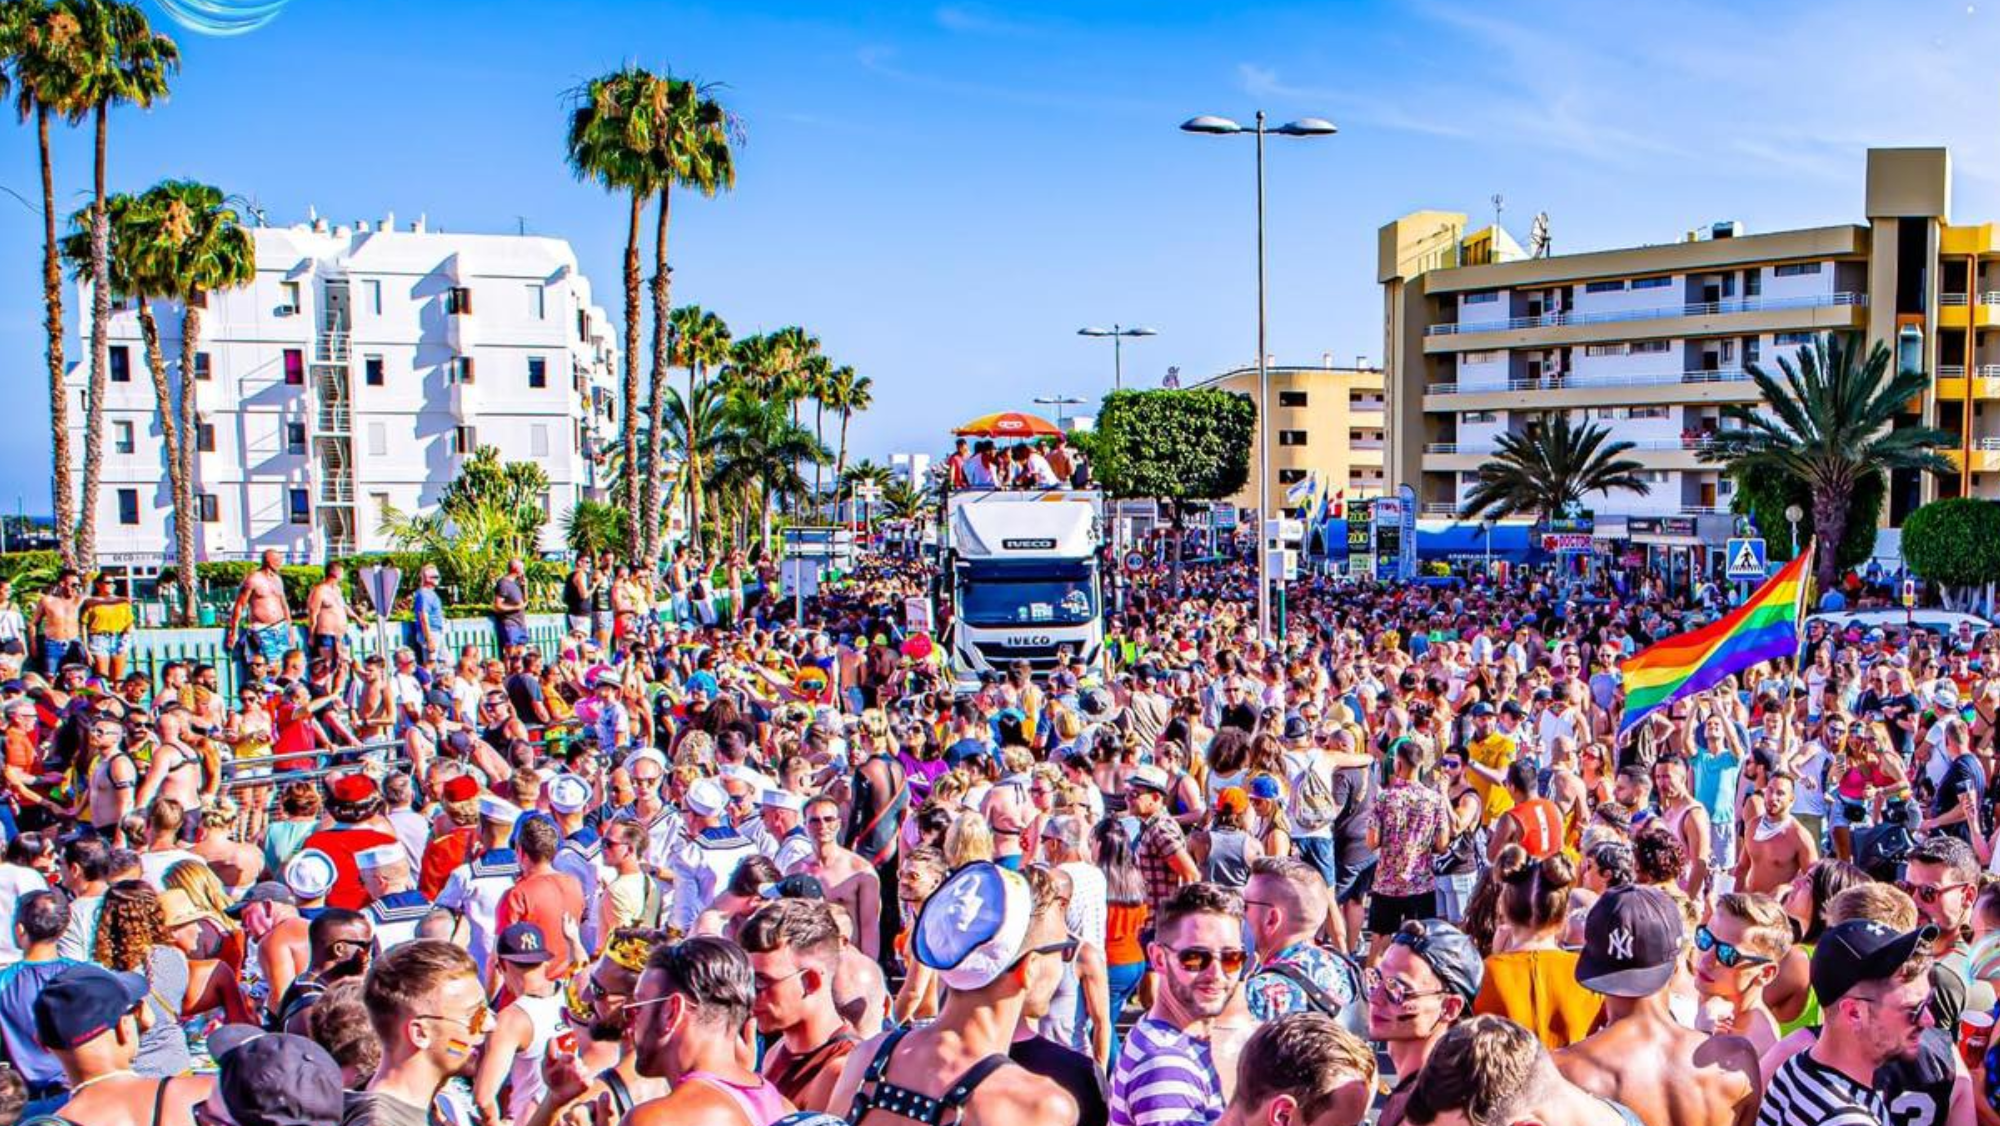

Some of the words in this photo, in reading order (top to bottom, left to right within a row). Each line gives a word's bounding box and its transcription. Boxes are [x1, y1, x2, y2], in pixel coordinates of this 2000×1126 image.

[1559, 535, 1591, 547] DOCTOR
[1129, 557, 1142, 566] 40
[1007, 635, 1051, 646] IVECO
[520, 932, 539, 950] NY
[1607, 927, 1634, 960] NY
